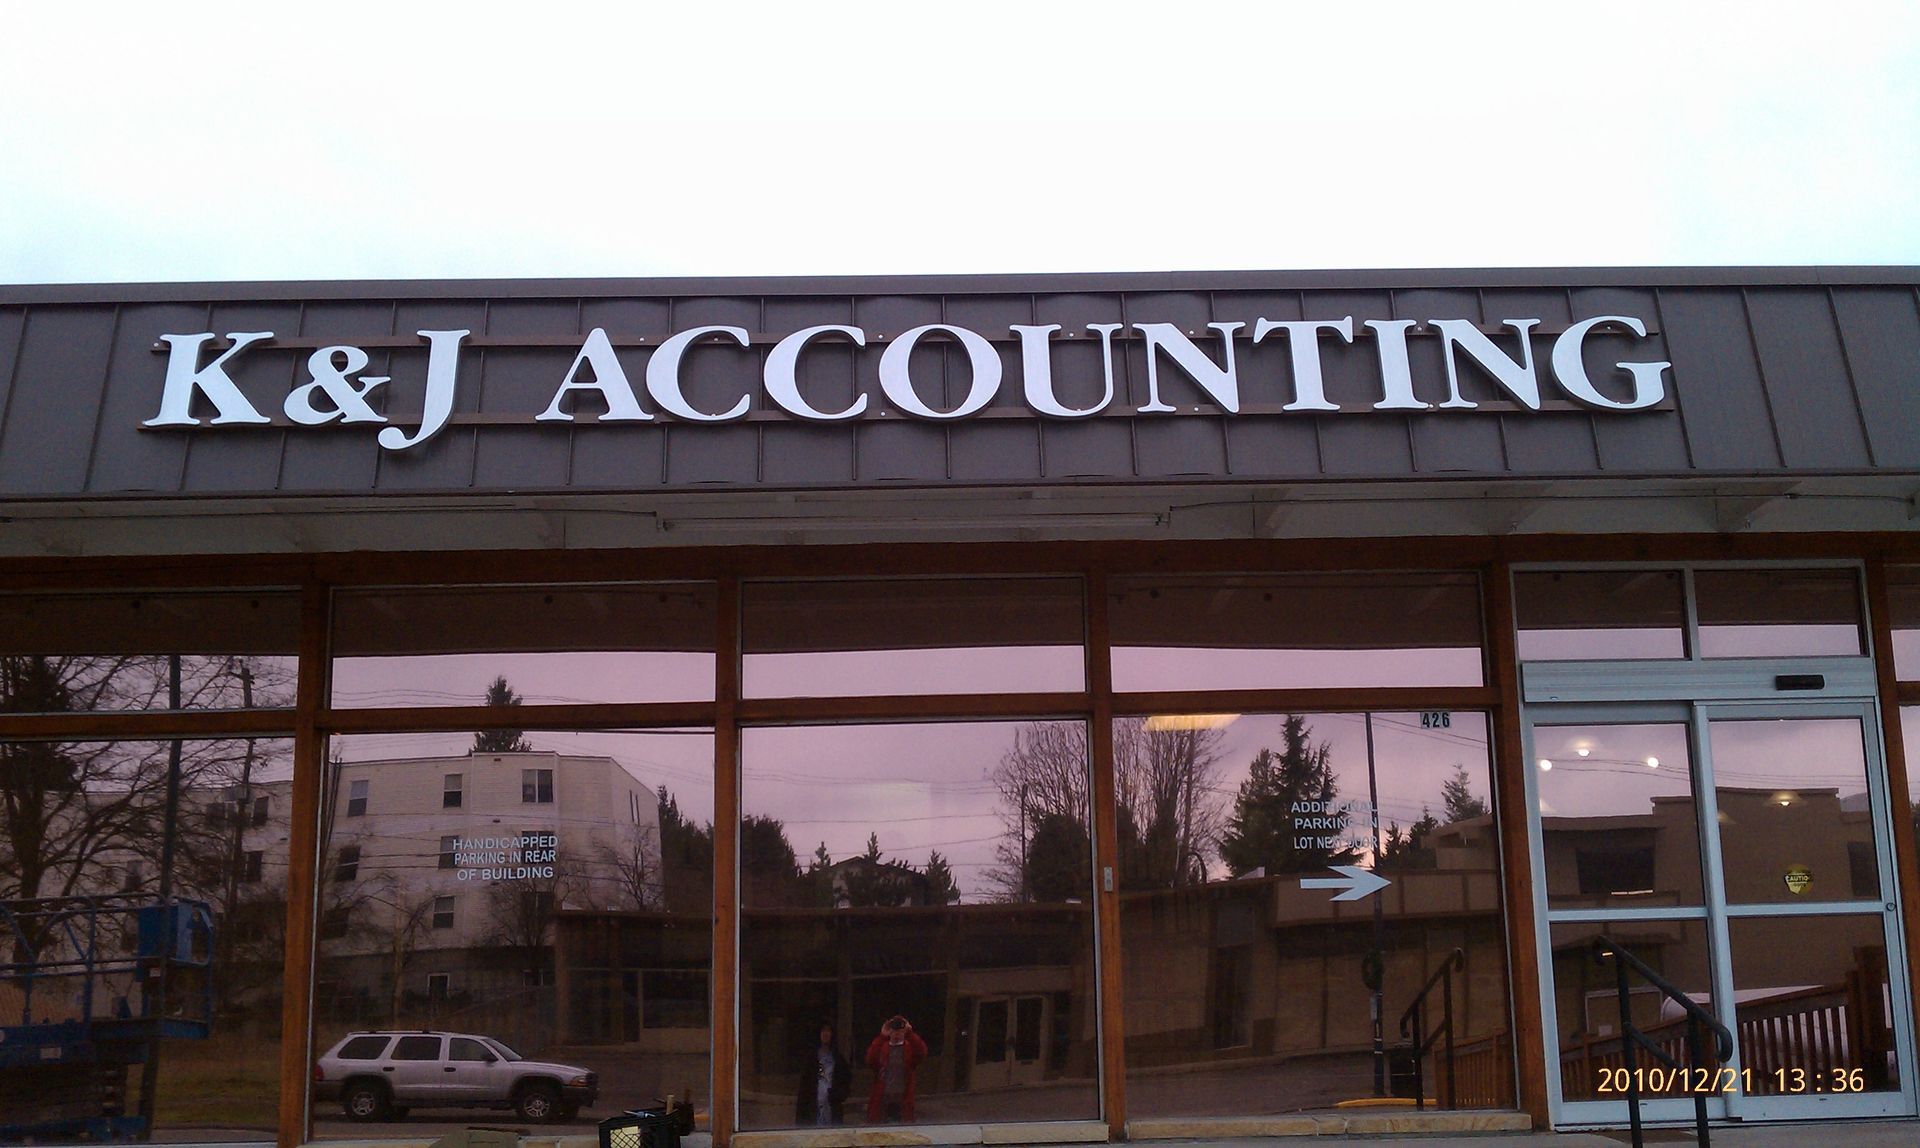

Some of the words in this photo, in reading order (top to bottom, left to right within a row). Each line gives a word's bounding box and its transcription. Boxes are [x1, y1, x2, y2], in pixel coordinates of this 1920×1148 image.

[142, 328, 471, 450] K&J
[535, 315, 1672, 425] ACCOUNTING
[1422, 712, 1450, 728] 426
[1294, 816, 1353, 830] PARKING
[453, 835, 558, 850] HANDICAPPED
[1294, 836, 1313, 849] LOT
[1348, 835, 1378, 848] DOOR
[454, 852, 505, 865] PARKING
[509, 851, 521, 863] IN
[525, 849, 556, 863] REAR
[457, 868, 477, 881] OF
[482, 866, 554, 880] BUILDING
